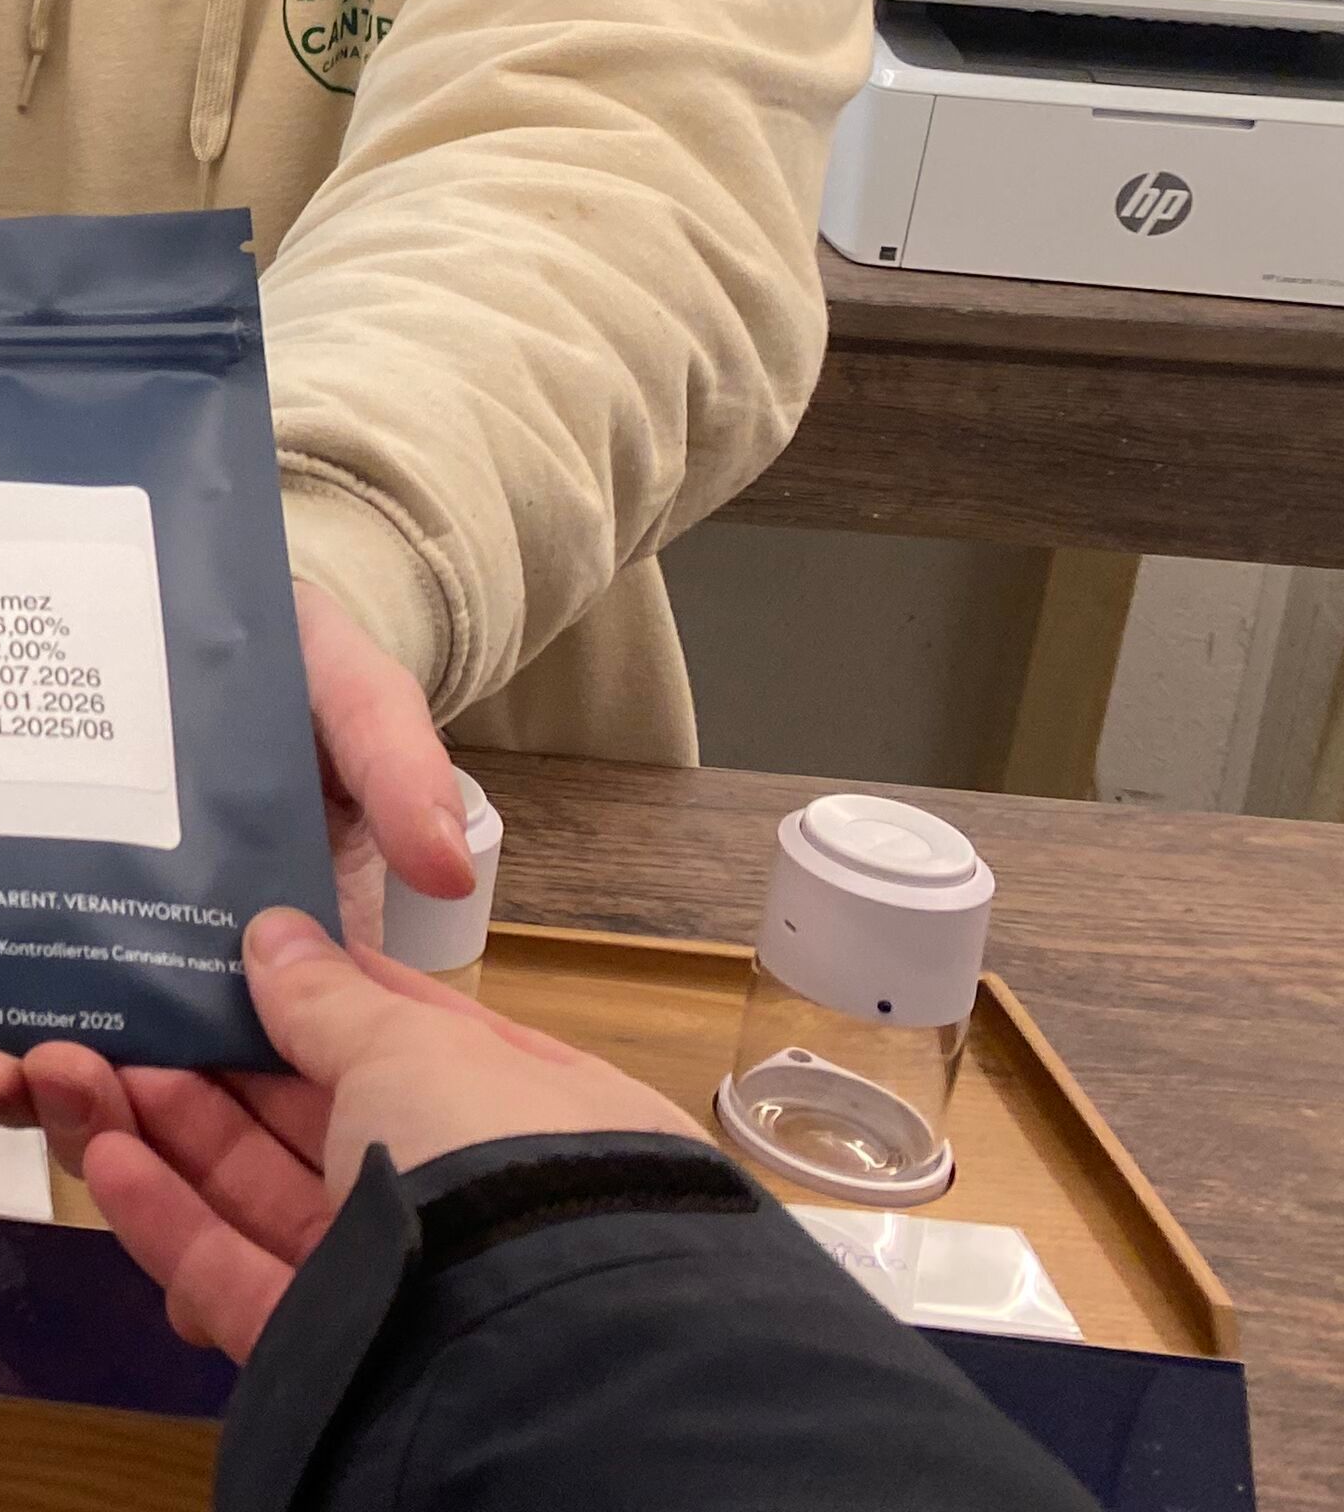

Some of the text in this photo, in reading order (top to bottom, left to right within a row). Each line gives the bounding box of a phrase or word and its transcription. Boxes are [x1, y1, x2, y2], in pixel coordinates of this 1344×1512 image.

[1119, 172, 1191, 235] hp
[111, 944, 185, 968] Cannabis
[7, 1007, 75, 1029] Oktober
[79, 1011, 125, 1031] 2025
